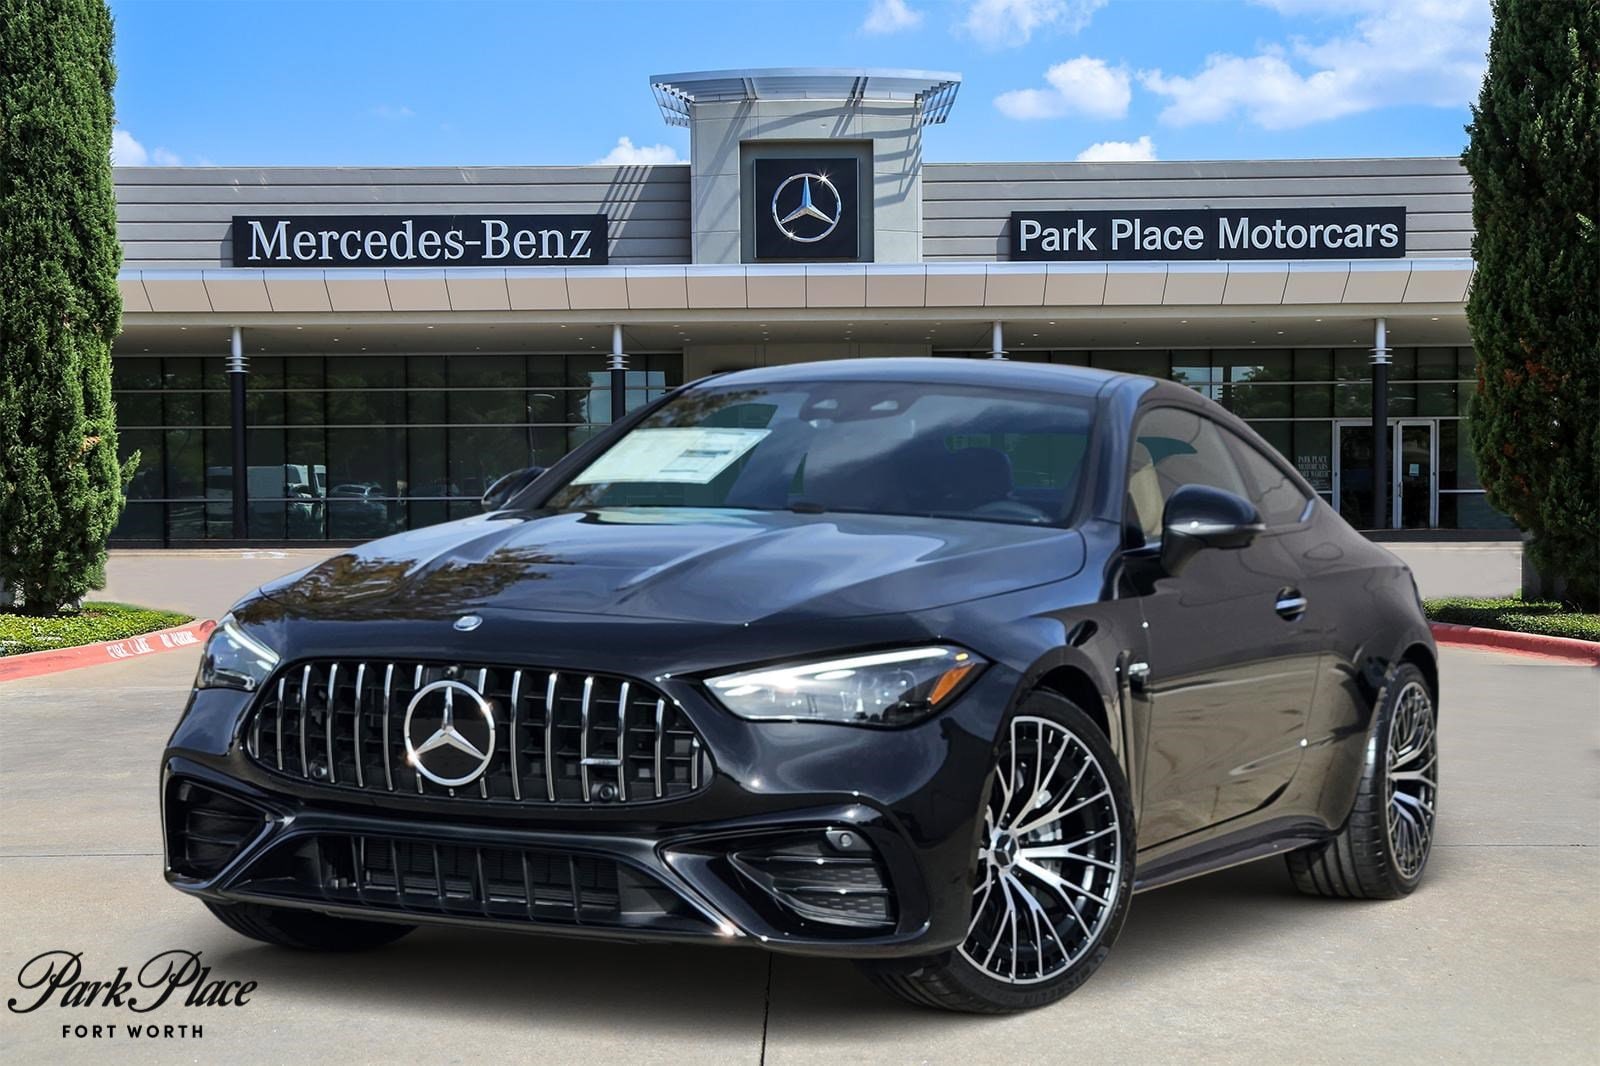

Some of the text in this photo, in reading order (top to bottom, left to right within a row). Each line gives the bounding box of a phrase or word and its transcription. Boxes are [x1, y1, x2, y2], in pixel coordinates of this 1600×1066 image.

[247, 219, 592, 260] Mercedes-Benz
[1020, 217, 1399, 252] Park Place Motorcars
